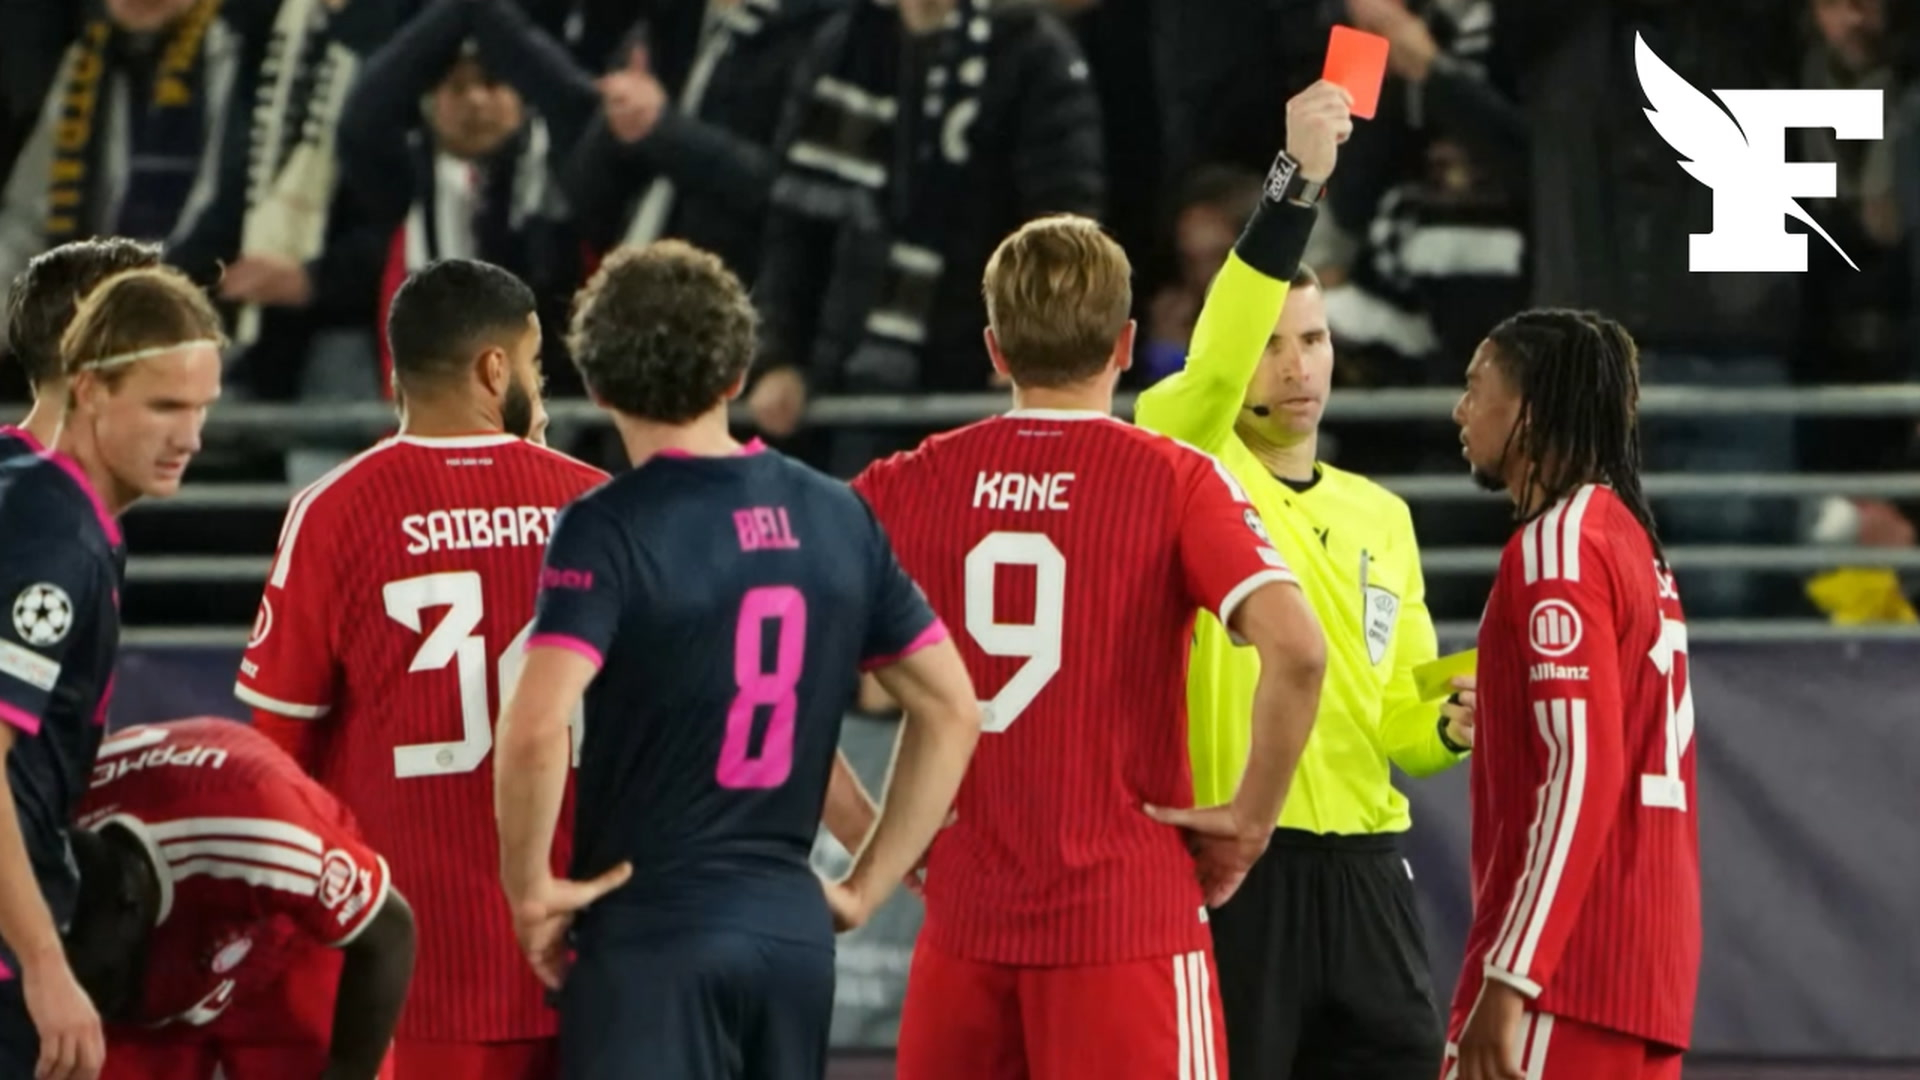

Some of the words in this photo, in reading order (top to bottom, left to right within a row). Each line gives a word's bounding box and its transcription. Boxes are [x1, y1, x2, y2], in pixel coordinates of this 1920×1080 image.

[972, 471, 1076, 512] KANE
[733, 508, 800, 551] BELL
[963, 531, 1067, 732] 9
[715, 586, 807, 790] 8
[1529, 662, 1590, 682] Allianz
